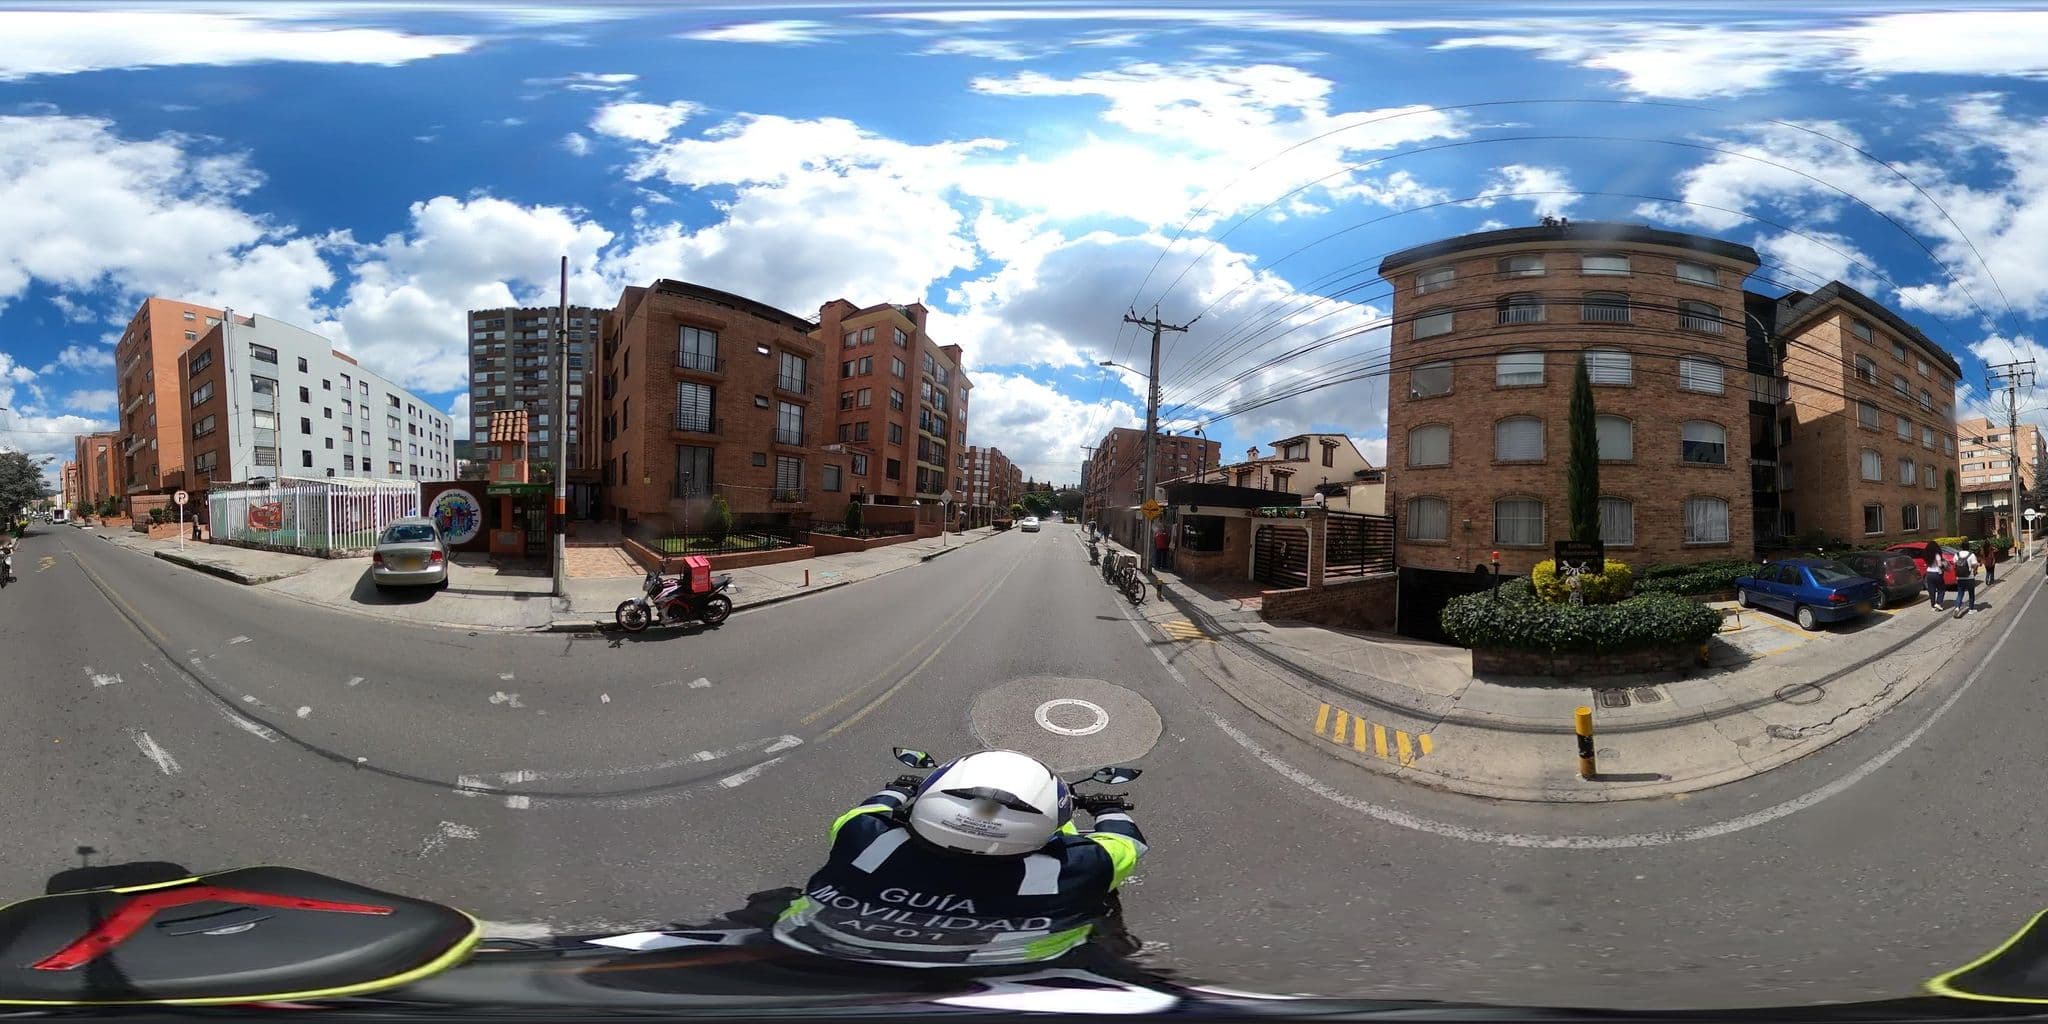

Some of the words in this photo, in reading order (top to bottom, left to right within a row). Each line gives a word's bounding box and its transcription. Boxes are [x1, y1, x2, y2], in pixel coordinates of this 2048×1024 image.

[810, 884, 1052, 931] MOVILIDAD
[880, 887, 976, 914] GUÍA
[838, 919, 945, 940] AF01
